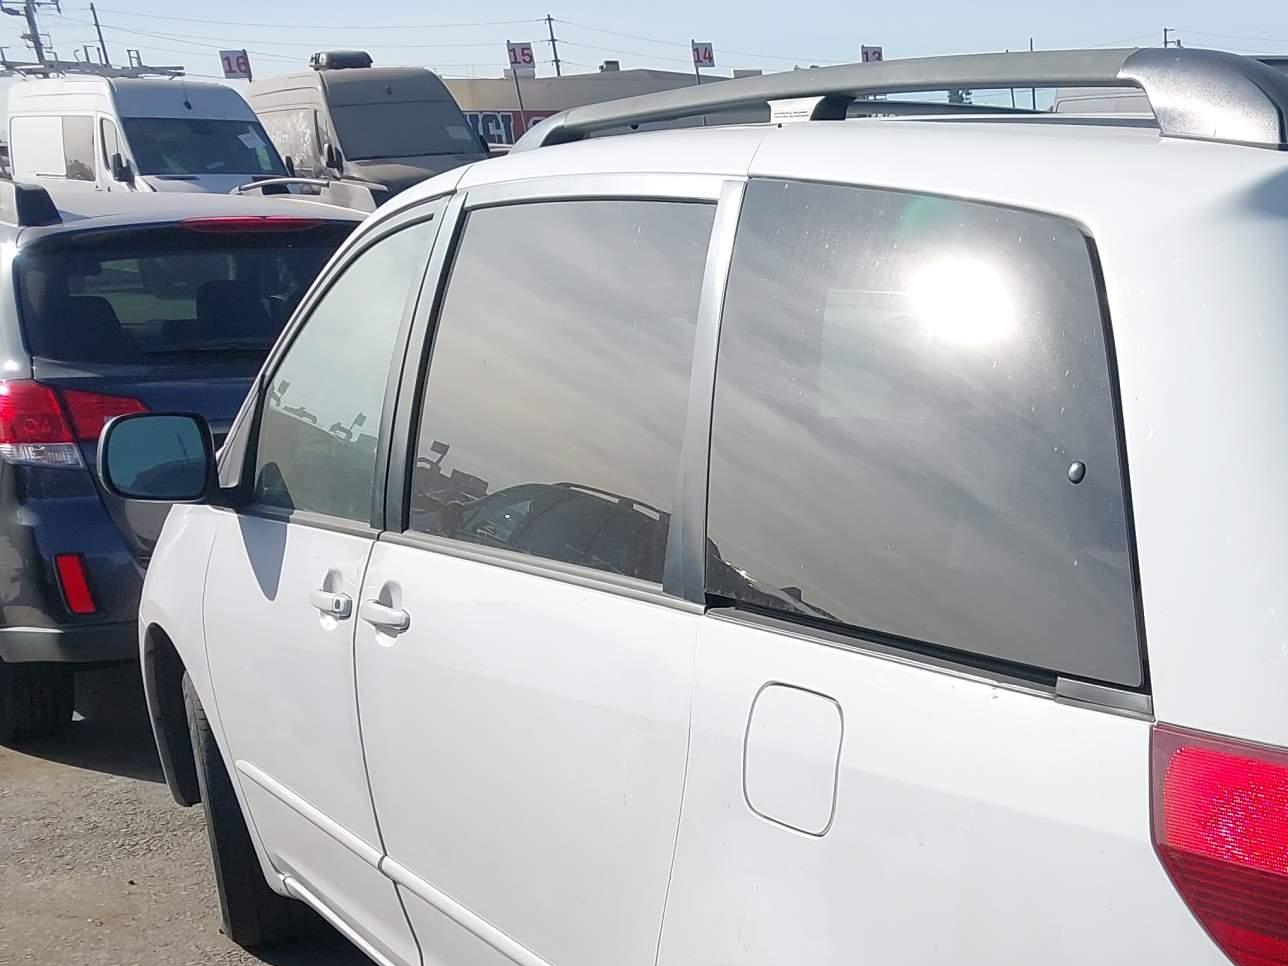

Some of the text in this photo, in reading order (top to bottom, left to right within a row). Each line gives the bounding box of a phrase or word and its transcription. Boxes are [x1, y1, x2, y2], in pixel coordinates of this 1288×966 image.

[223, 55, 247, 73] 16
[510, 47, 534, 64] 15
[693, 47, 713, 64] 14
